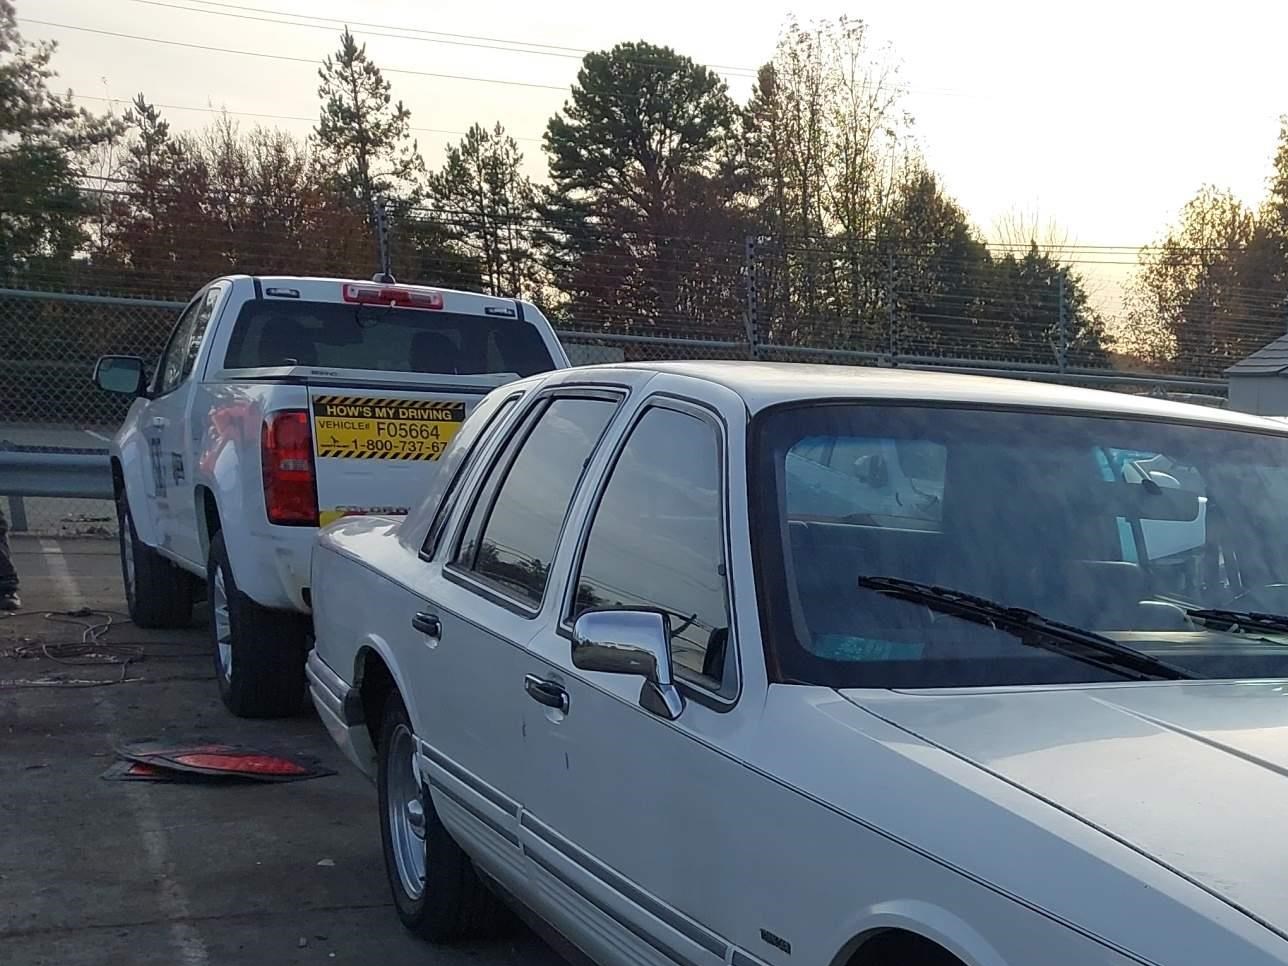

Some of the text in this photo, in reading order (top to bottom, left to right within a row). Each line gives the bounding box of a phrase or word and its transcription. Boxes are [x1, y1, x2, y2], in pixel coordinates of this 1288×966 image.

[326, 405, 453, 420] HOW'S MY DRIVING
